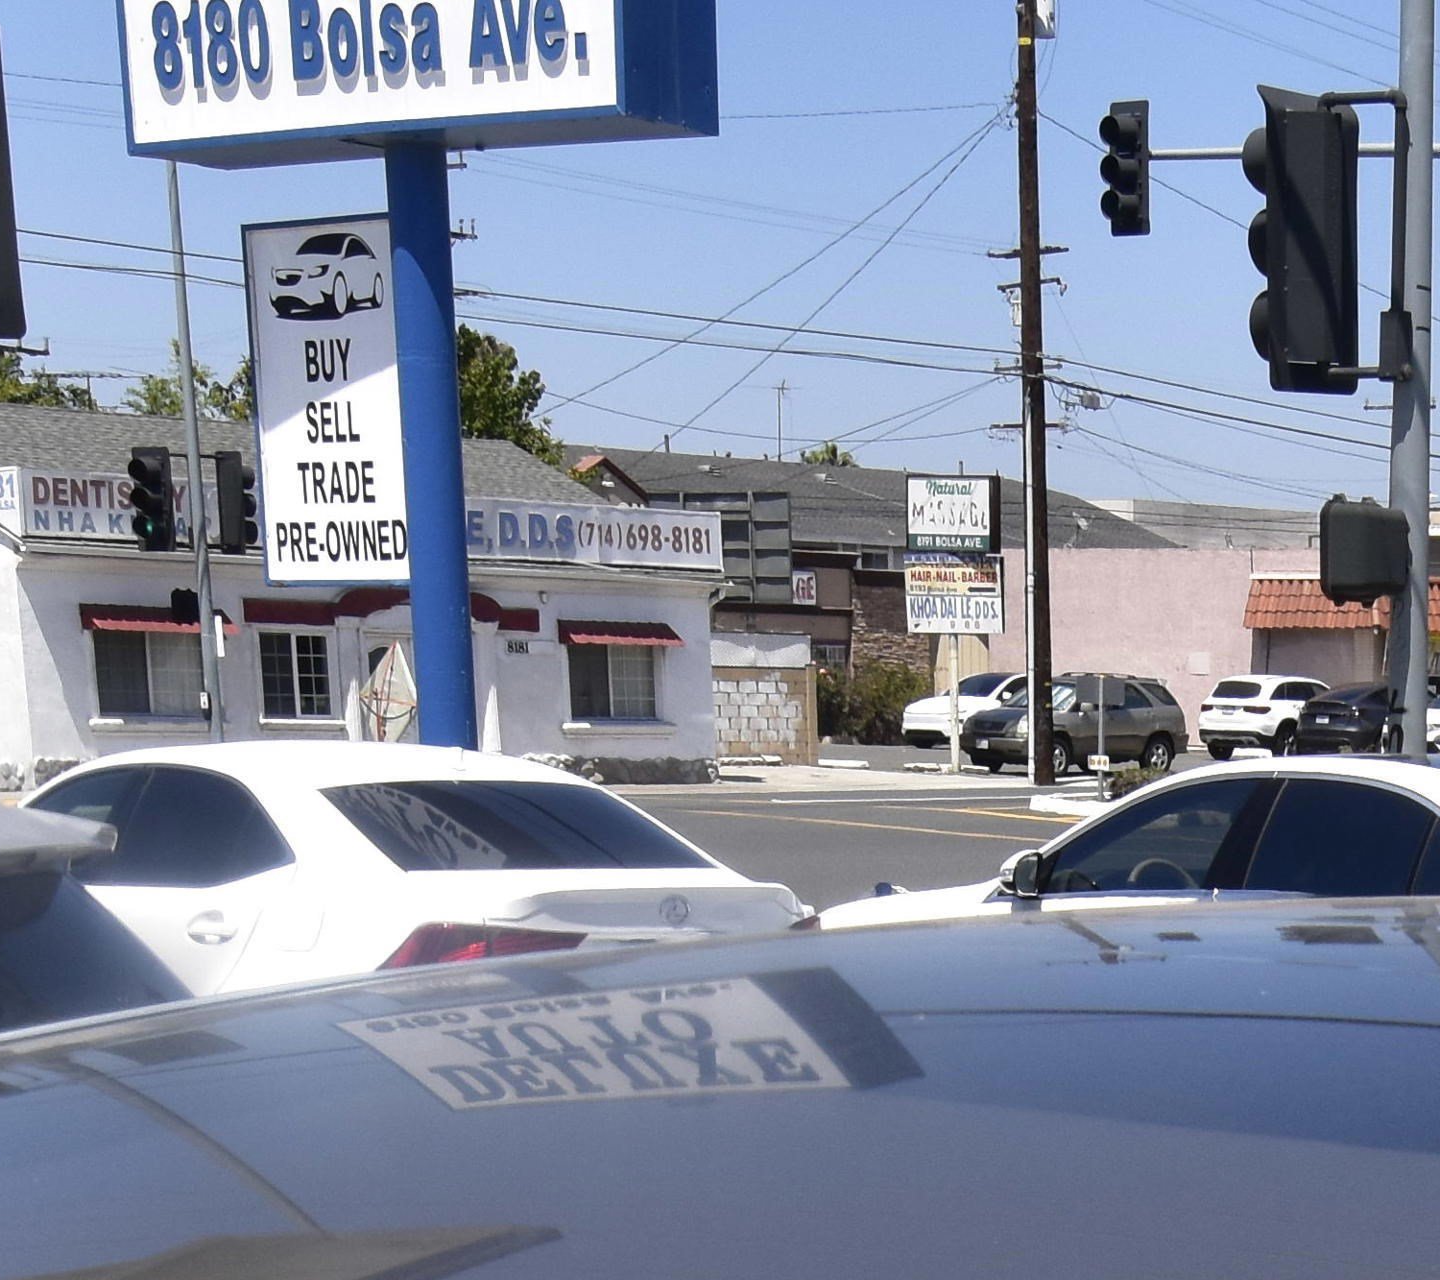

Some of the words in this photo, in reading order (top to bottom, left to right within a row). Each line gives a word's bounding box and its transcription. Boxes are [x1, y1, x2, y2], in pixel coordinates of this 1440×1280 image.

[152, 0, 270, 91] 8180
[288, 0, 443, 81] Bolsa
[468, 0, 587, 69] Ave.
[304, 338, 351, 383] BUY
[306, 400, 361, 444] SELL
[32, 476, 187, 514] DENTISY
[297, 460, 376, 504] TRADE
[926, 480, 971, 496] Natural
[276, 519, 407, 562] PRE-OWNED
[917, 536, 933, 547] 8191
[935, 536, 962, 548] BOLSA
[910, 597, 938, 619] KHOA
[940, 597, 957, 619] DAI
[508, 640, 529, 654] 8181
